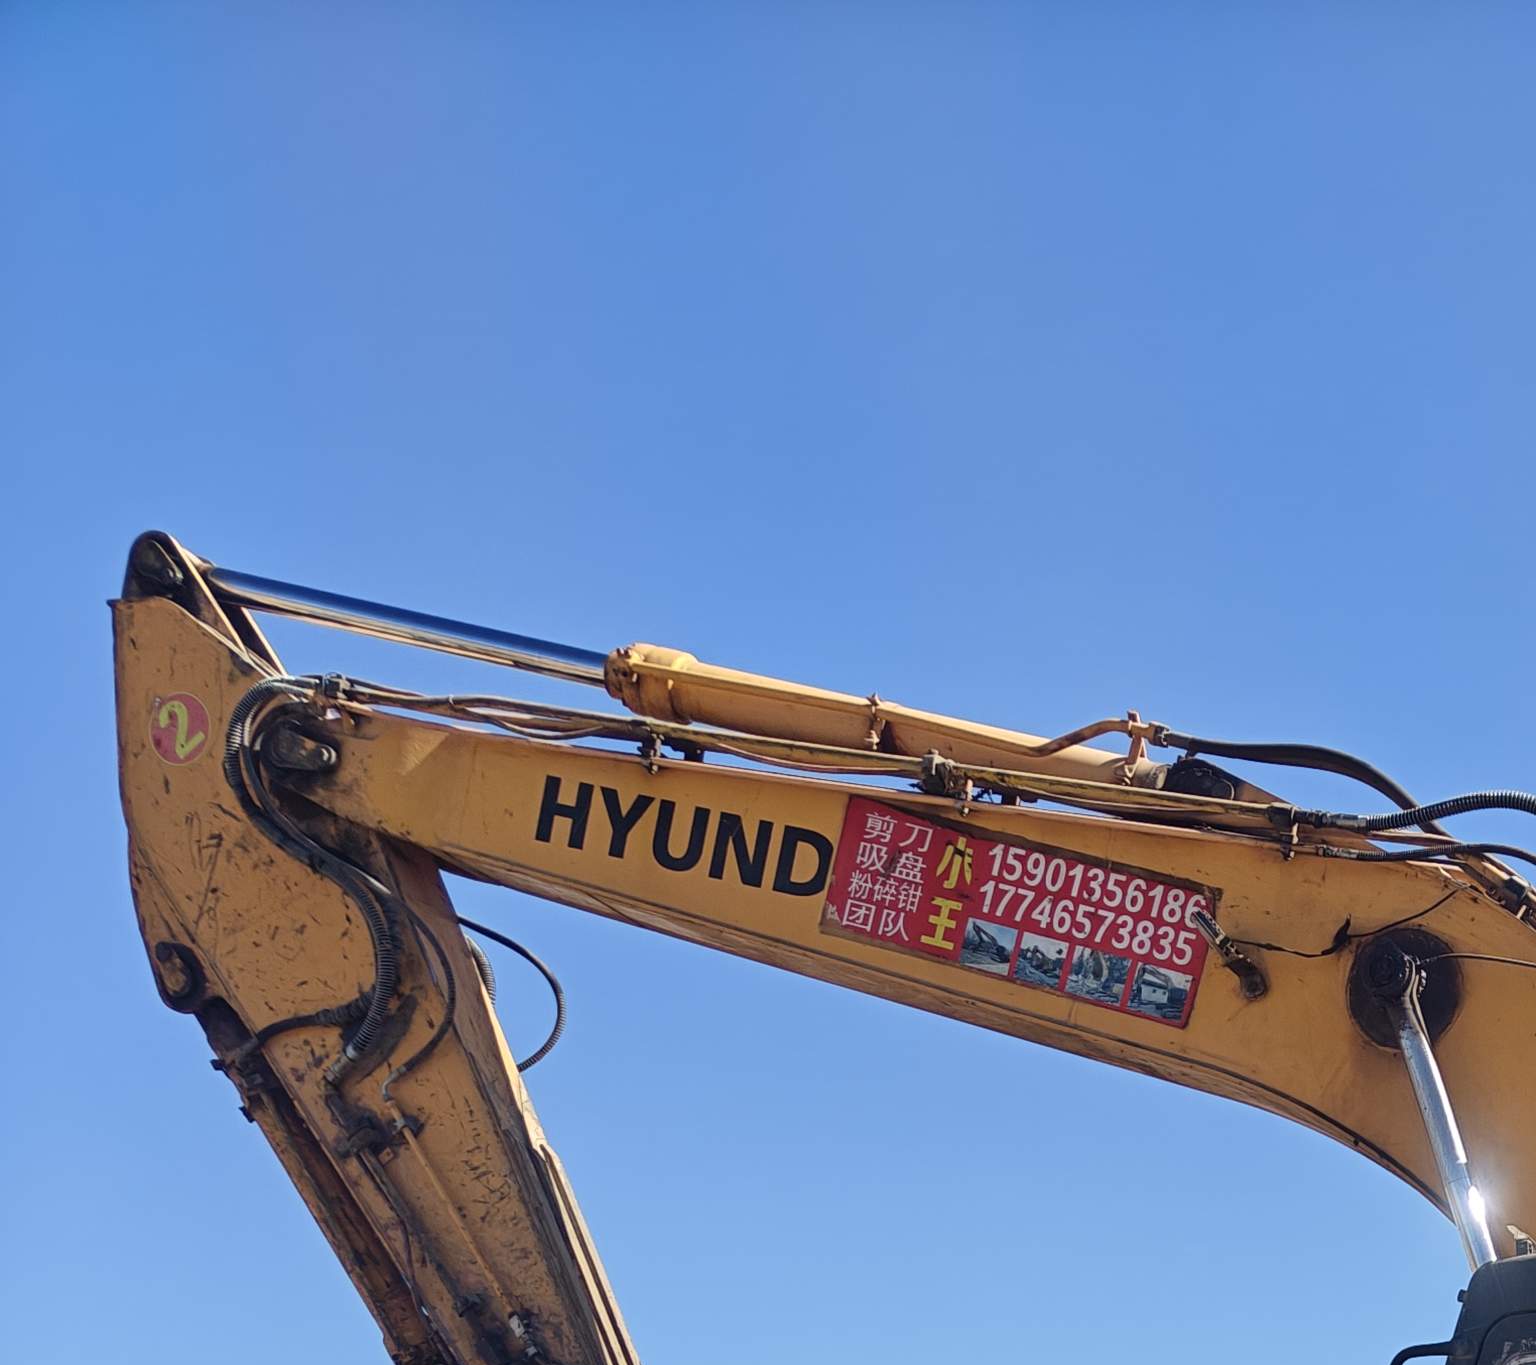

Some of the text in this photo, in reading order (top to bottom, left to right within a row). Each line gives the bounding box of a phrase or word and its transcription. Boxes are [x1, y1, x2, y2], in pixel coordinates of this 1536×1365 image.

[159, 700, 205, 759] 2
[535, 775, 834, 896] HYUND
[864, 812, 933, 852] 剪刀
[856, 842, 927, 884] 吸盘
[988, 843, 1206, 930] 15901356186
[848, 869, 923, 913] 粉碎钳
[842, 898, 910, 942] 团队
[979, 880, 1197, 966] 17746573835
